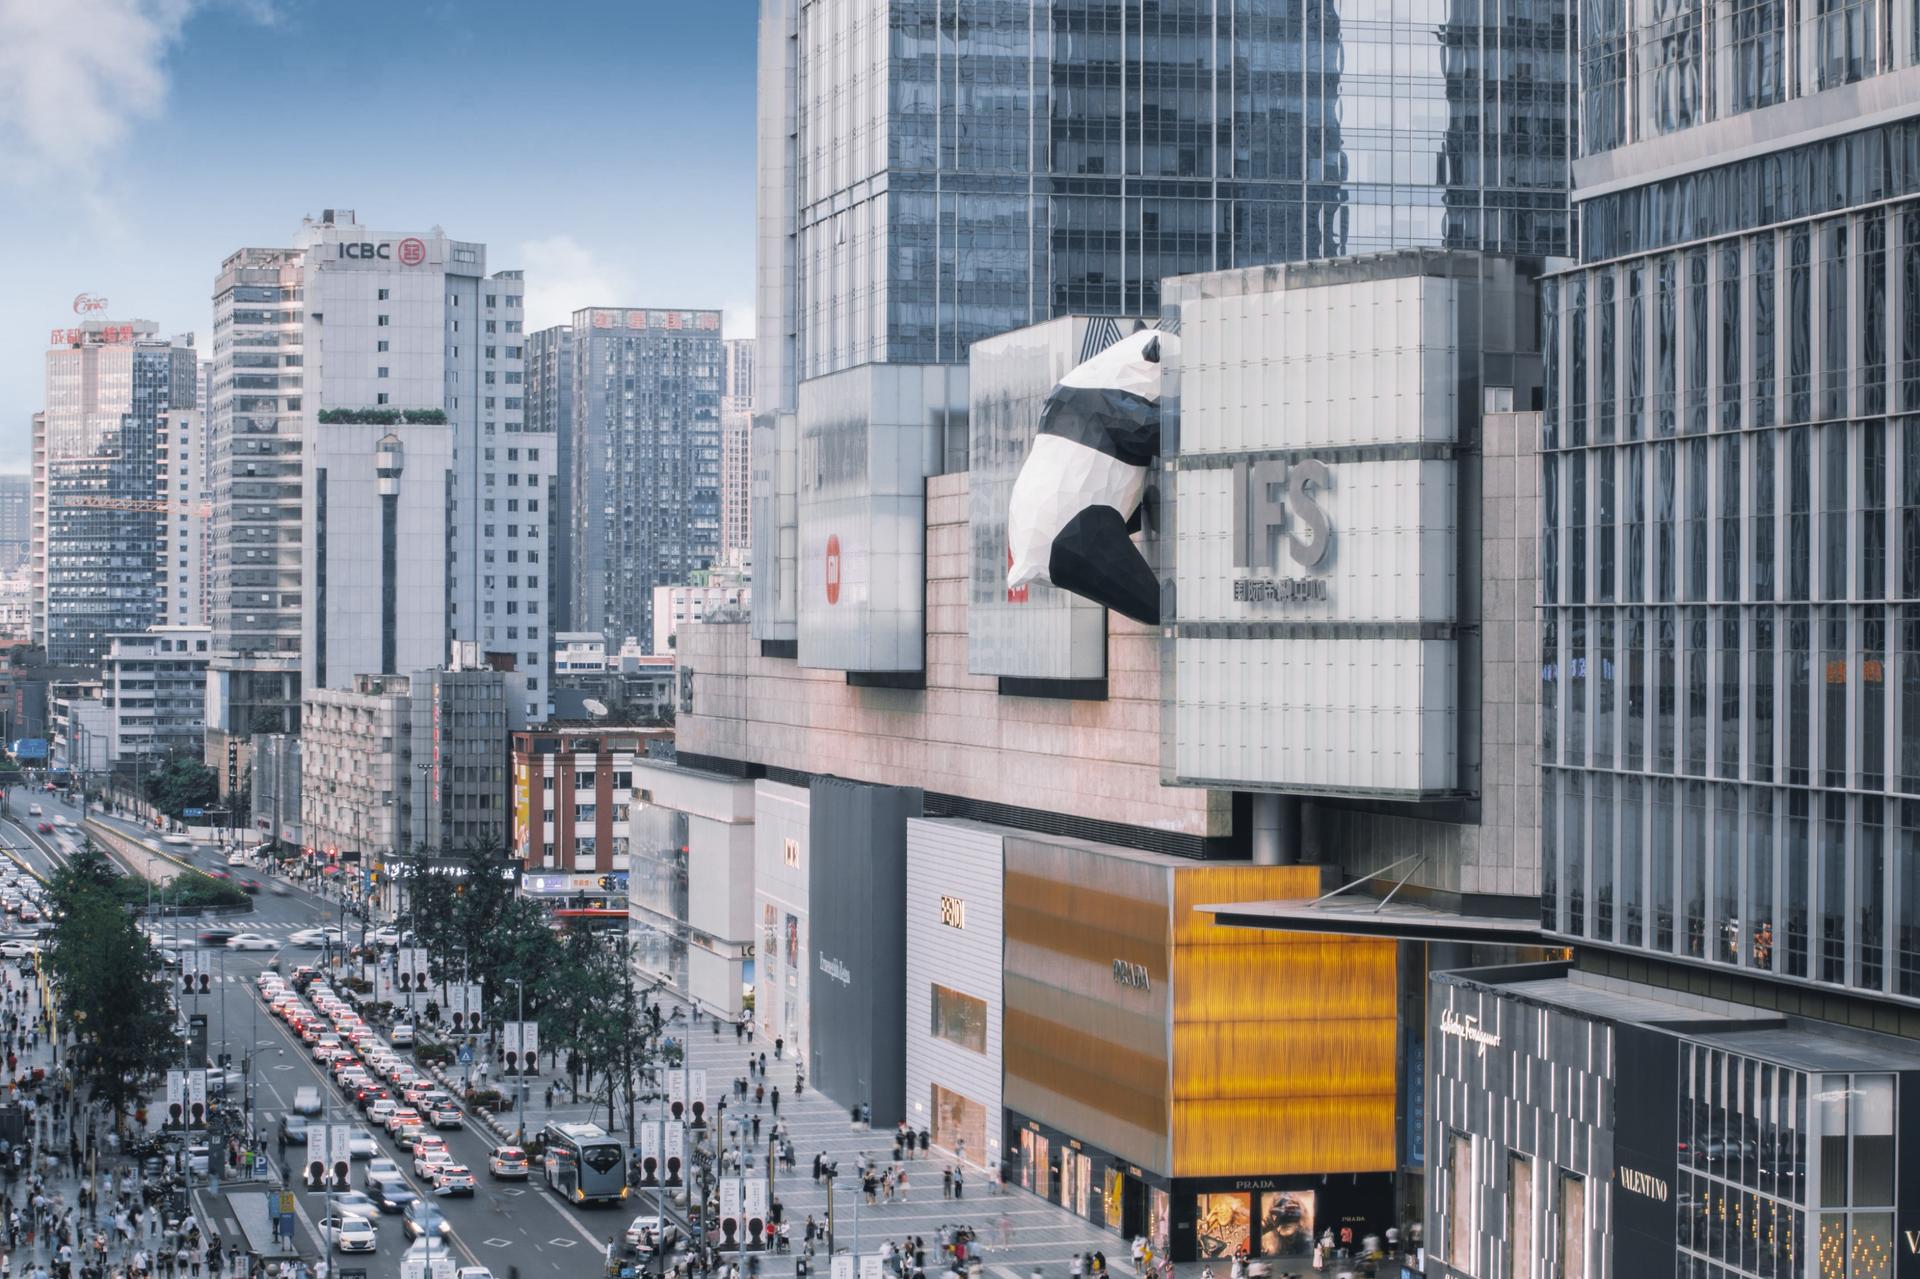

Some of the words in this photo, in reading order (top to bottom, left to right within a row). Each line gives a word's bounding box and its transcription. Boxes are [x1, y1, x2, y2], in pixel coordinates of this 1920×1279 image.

[339, 242, 390, 259] ICBC
[1233, 459, 1330, 568] IFS
[941, 895, 965, 930] FENDI
[1112, 958, 1150, 991] PRADA
[255, 1156, 266, 1169] P
[1235, 1180, 1276, 1190] PRADA
[1620, 1165, 1668, 1203] VALENTINO
